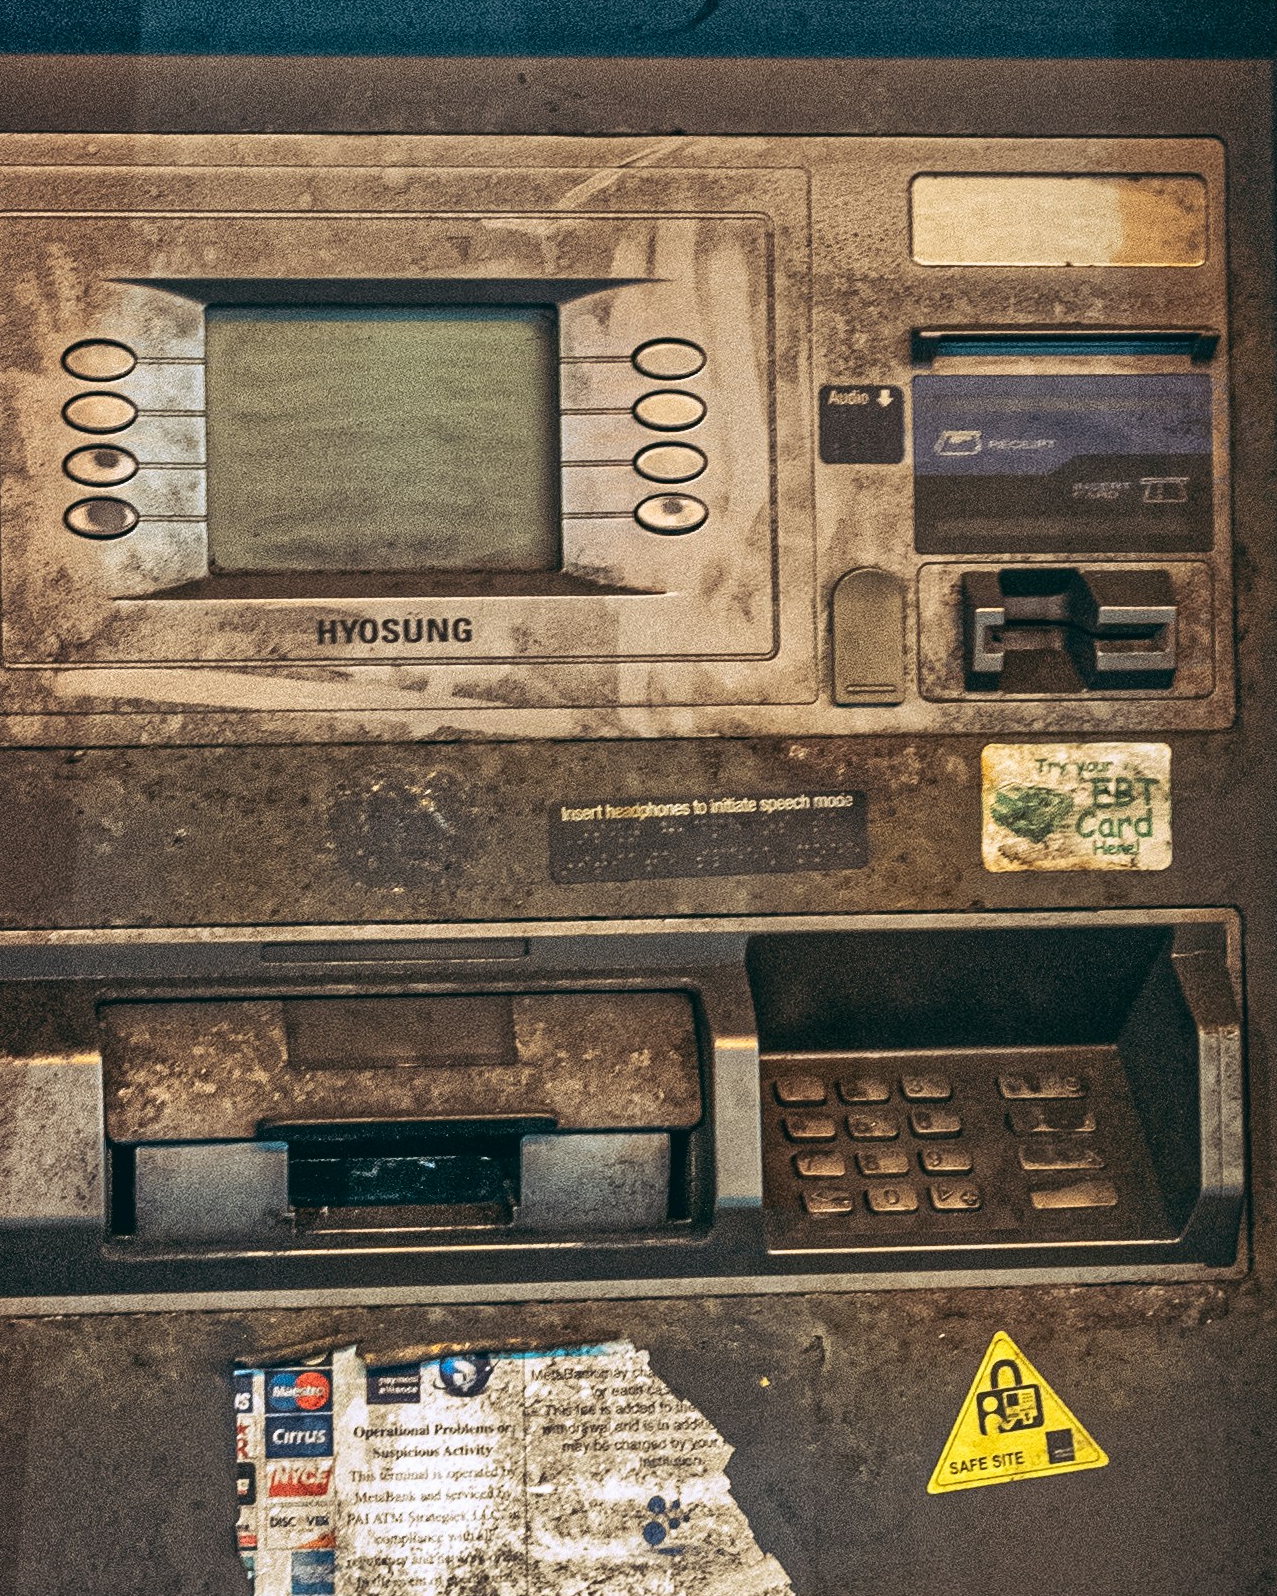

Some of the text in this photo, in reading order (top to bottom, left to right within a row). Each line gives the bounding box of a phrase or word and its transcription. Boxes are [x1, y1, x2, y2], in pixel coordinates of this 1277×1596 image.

[827, 389, 870, 405] Audio
[987, 438, 1057, 451] RECEIPT
[317, 617, 473, 645] HYOSUNG
[1034, 758, 1114, 776] Try your
[1090, 776, 1160, 808] EBT
[561, 792, 854, 822] Insert headphones to initiate speech mode
[1075, 808, 1153, 838] Card
[273, 1428, 326, 1444] Cirrus
[353, 1424, 430, 1440] Operational
[434, 1423, 494, 1436] Problems
[373, 1444, 494, 1460] Suspicious Activity
[950, 1451, 1026, 1475] SAFE SITE
[350, 1470, 375, 1482] This
[380, 1468, 428, 1481] terminal
[354, 1489, 416, 1504] MetaBank
[373, 1511, 403, 1524] ATM
